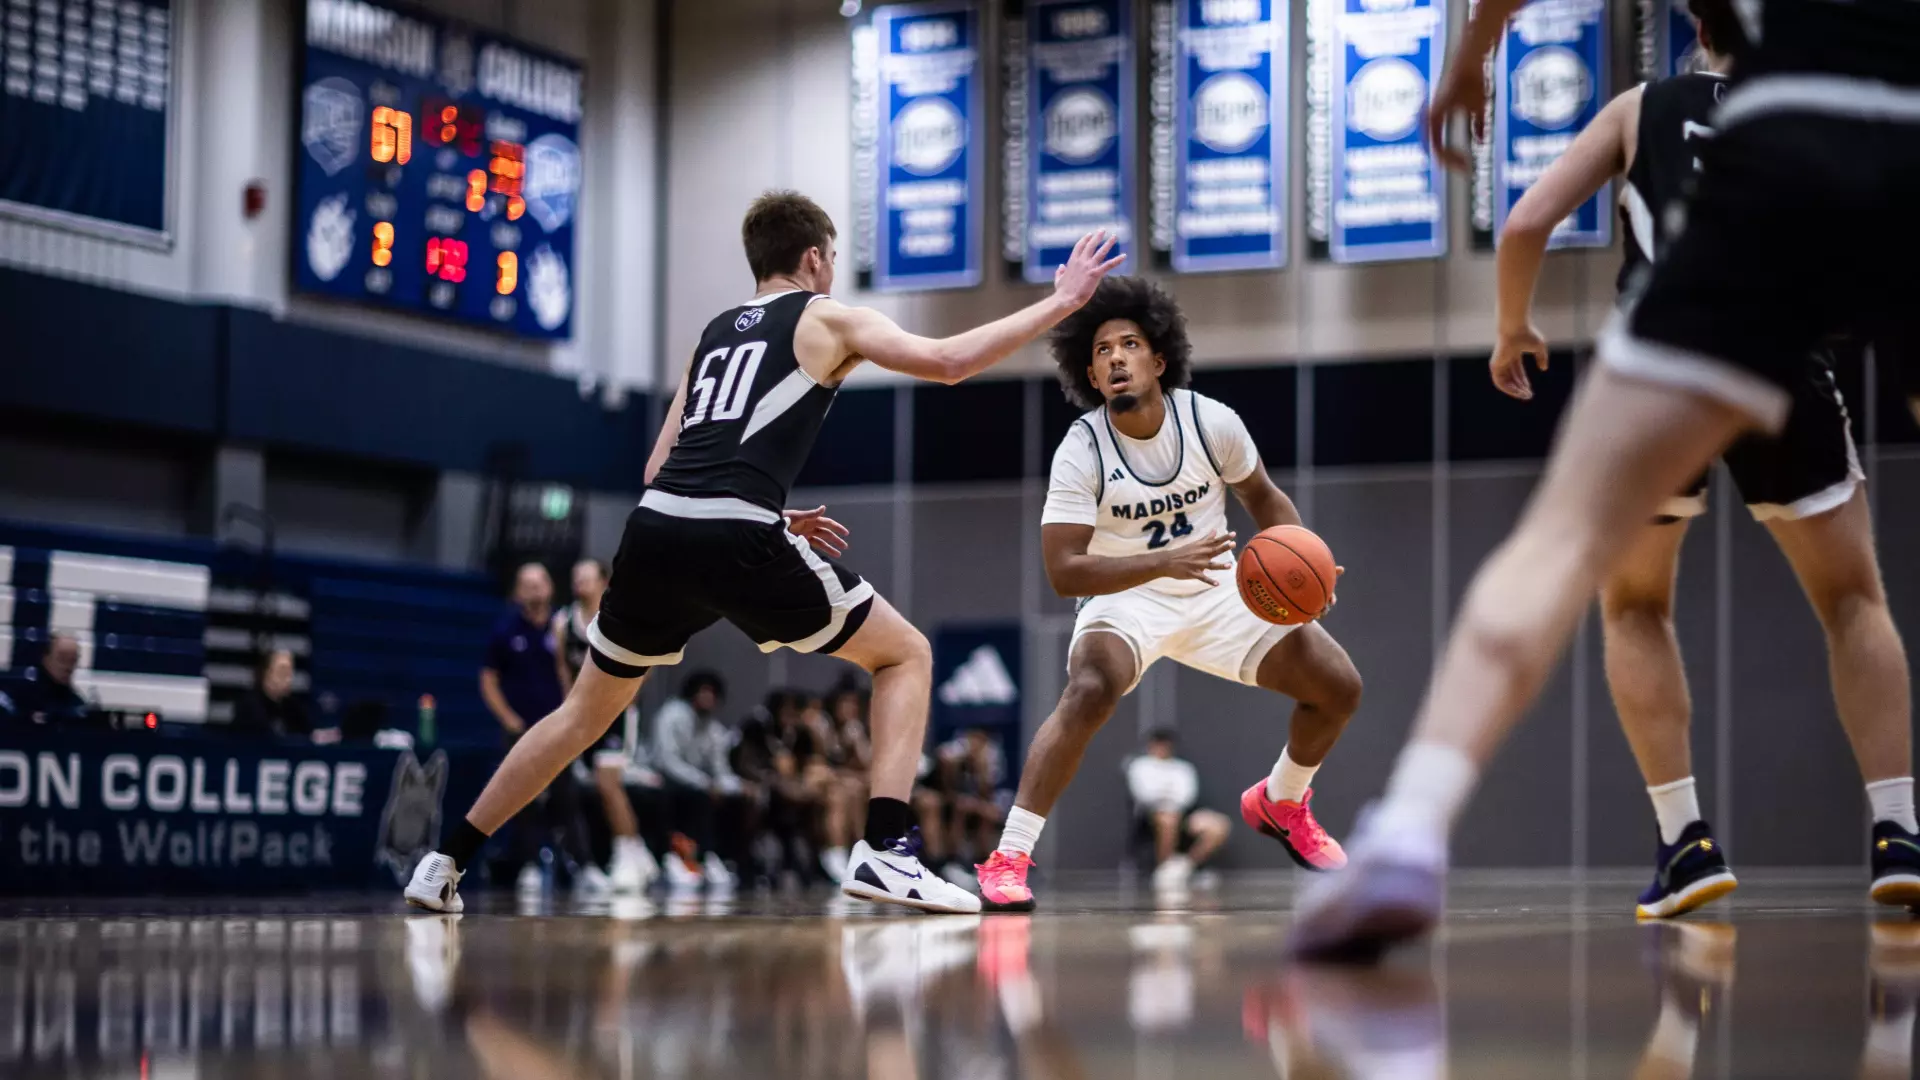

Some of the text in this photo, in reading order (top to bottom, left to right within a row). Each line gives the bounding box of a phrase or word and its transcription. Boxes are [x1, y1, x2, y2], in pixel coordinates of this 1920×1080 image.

[1111, 481, 1210, 520] MADISON
[1142, 511, 1194, 550] 24
[0, 750, 367, 816] ON COLLEGE
[19, 819, 333, 867] the WolfPack
